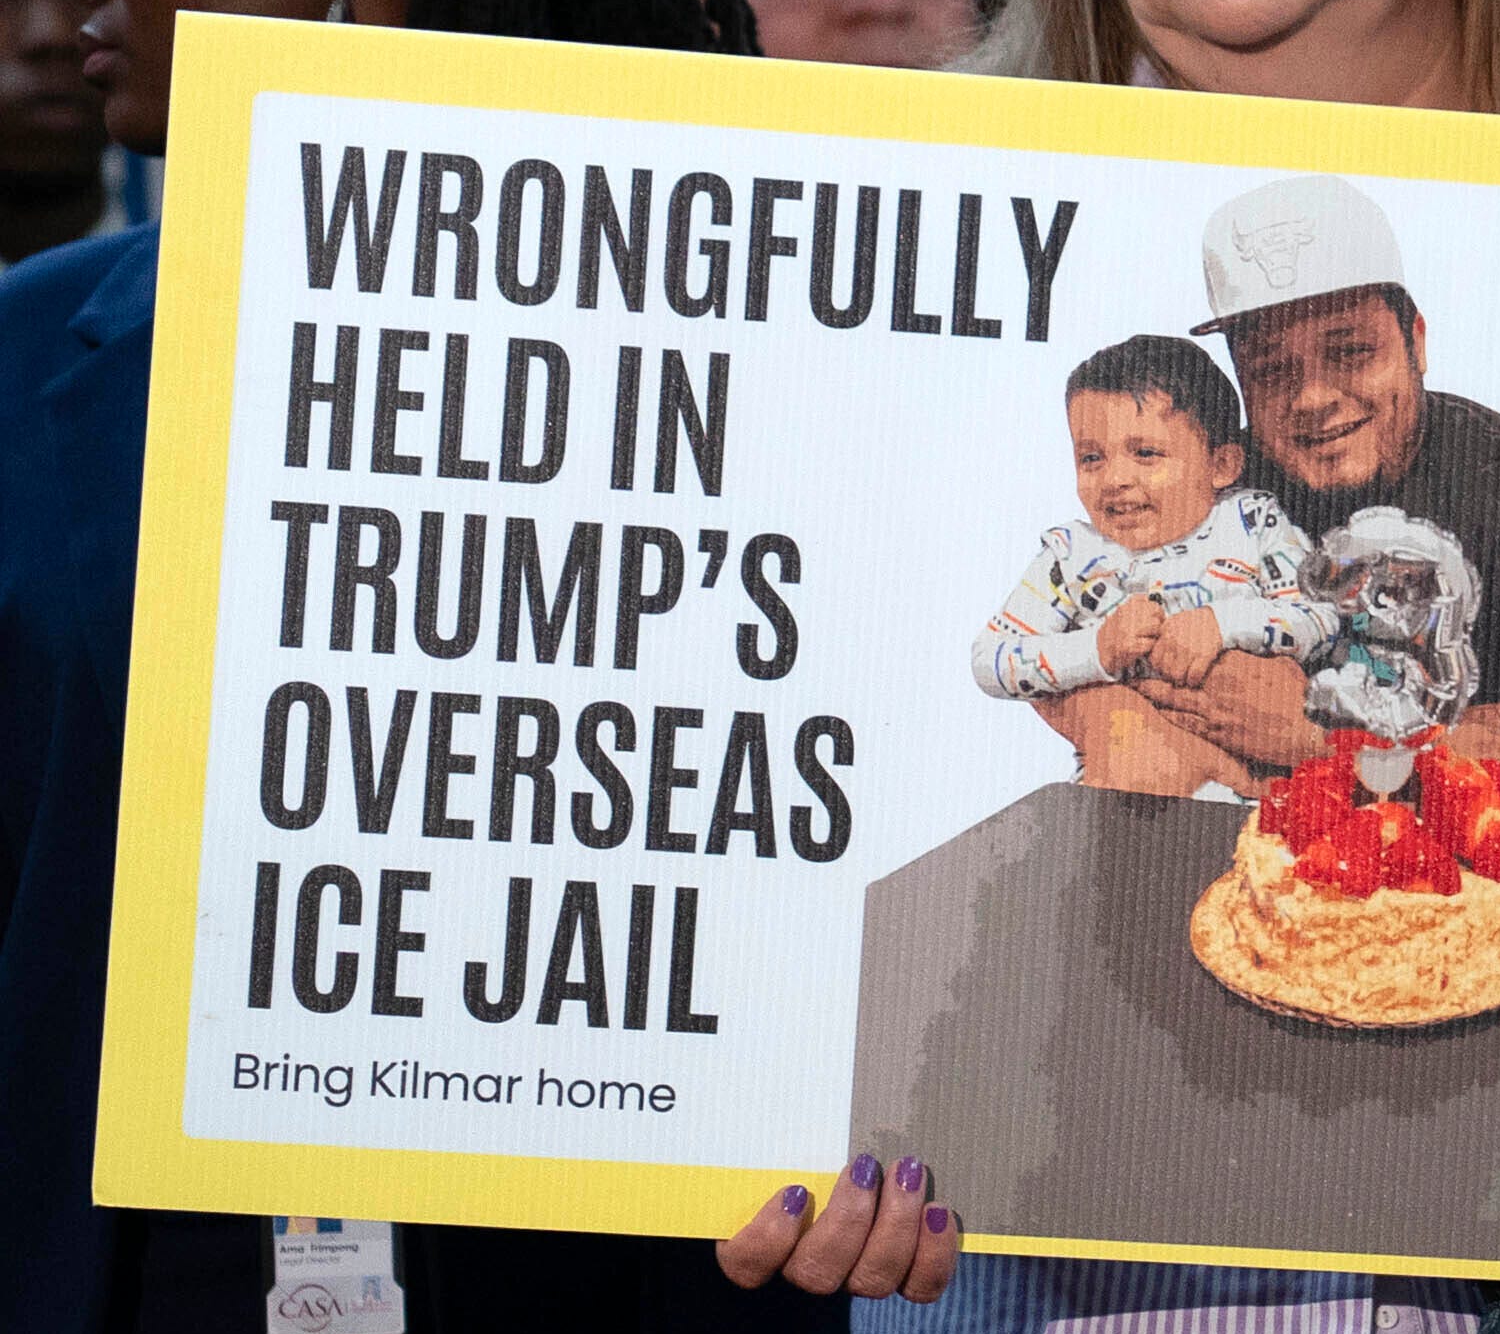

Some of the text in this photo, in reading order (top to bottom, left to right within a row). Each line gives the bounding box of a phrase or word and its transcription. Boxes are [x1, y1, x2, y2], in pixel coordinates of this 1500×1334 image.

[299, 142, 1079, 343] WRONGFULLY
[284, 321, 732, 498] HELD IN
[270, 499, 802, 681] TRUMP'S
[258, 680, 855, 864] OVERSEAS
[246, 861, 720, 1036] ICE JAIL
[232, 1051, 678, 1114] Bring Kilmar home
[277, 1298, 344, 1320] CASA
